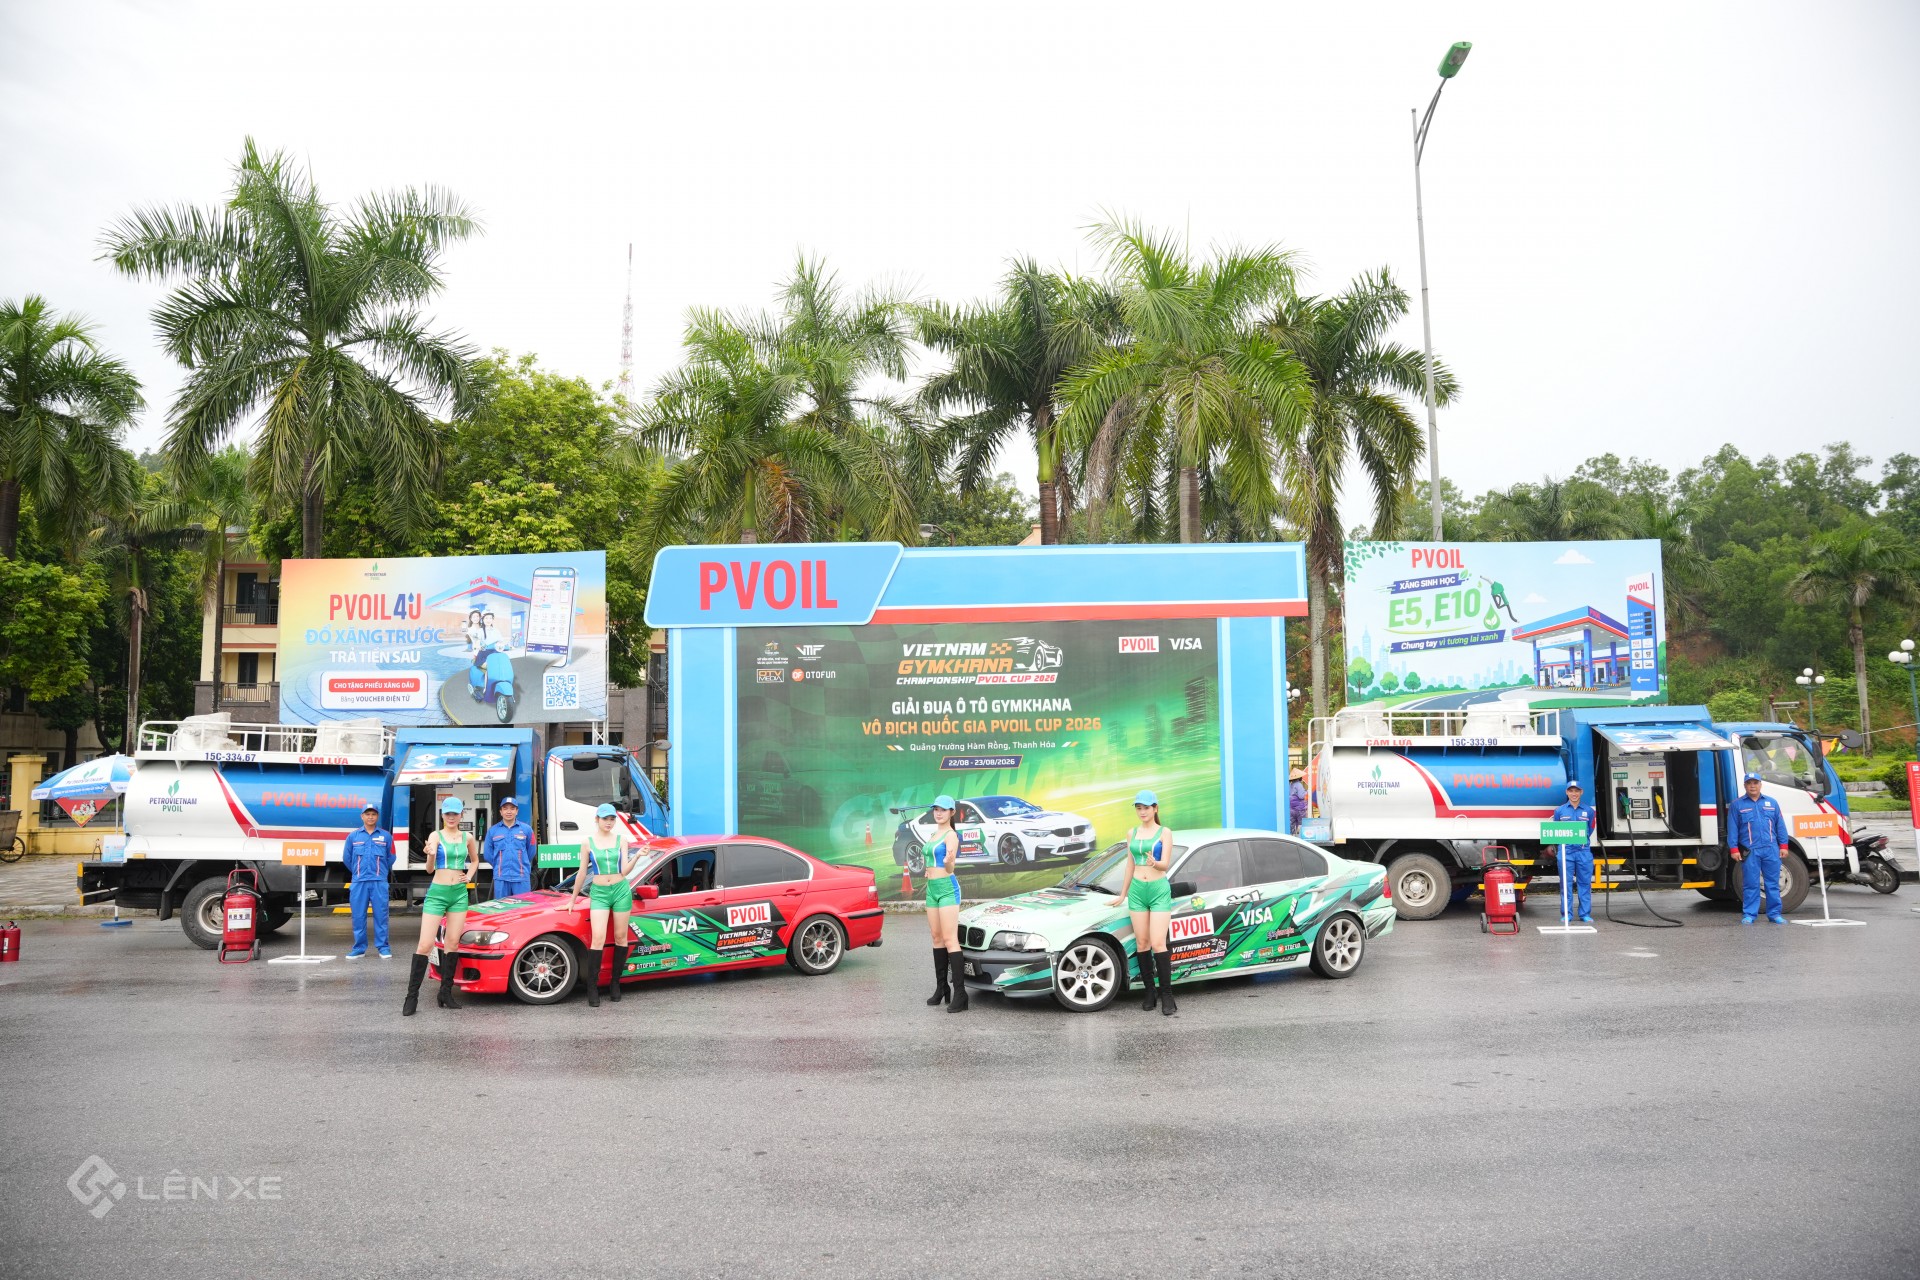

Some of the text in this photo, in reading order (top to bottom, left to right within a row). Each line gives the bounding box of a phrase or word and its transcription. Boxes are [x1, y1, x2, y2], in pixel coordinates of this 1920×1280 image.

[1411, 549, 1465, 569] PVOIL
[700, 560, 838, 611] PVOIL
[1400, 576, 1456, 590] XĂNG SINH HỌC
[1628, 581, 1650, 592] PVOIL
[306, 623, 445, 644] ĐỔ XĂNG TRƯỚC
[1121, 638, 1156, 651] PVOIL
[1168, 637, 1202, 650] VISA
[1401, 641, 1424, 650] Chung
[1426, 640, 1437, 649] tay
[1447, 636, 1468, 646] tương
[1470, 634, 1479, 642] lai
[1480, 633, 1498, 641] xanh
[330, 647, 421, 664] TRẢ TIỀN SAU
[902, 642, 987, 657] VIETNAM
[897, 658, 1013, 674] GYMKHANA
[805, 670, 836, 679] OTOFUN
[896, 674, 1055, 686] CHAMPIONSHIP PVOIL CUP 2026
[891, 697, 1072, 715] GIẢI ĐUA Ô TÔ GYMKHANA
[862, 715, 1102, 738] VÔ ĐỊCH QUỐC GIA PVOIL CUP 2026
[909, 740, 1056, 752] Quảng trường Hàm Rồng, Thanh Hóa
[1451, 738, 1498, 746] 15C-333.90
[205, 752, 256, 762] 15C-334.67
[948, 759, 969, 767] 22/08
[974, 758, 1015, 767] 23/08/2026
[1453, 773, 1552, 789] PVOIL Mobile
[149, 797, 197, 805] PETROVIETNAM
[261, 791, 367, 808] PVOIL Mobile
[162, 804, 183, 812] PVOIL
[964, 831, 979, 839] PVOIL
[1542, 829, 1553, 837] E10
[1554, 829, 1573, 837] RON95
[540, 852, 551, 861] E10
[730, 906, 768, 925] PVOIL
[1237, 906, 1274, 926] VISA
[657, 916, 698, 934] VISA
[1171, 916, 1211, 938] PVOIL
[717, 935, 757, 947] GYMKHANA
[719, 931, 748, 940] VIETNAM
[1172, 942, 1202, 953] VIETNAM
